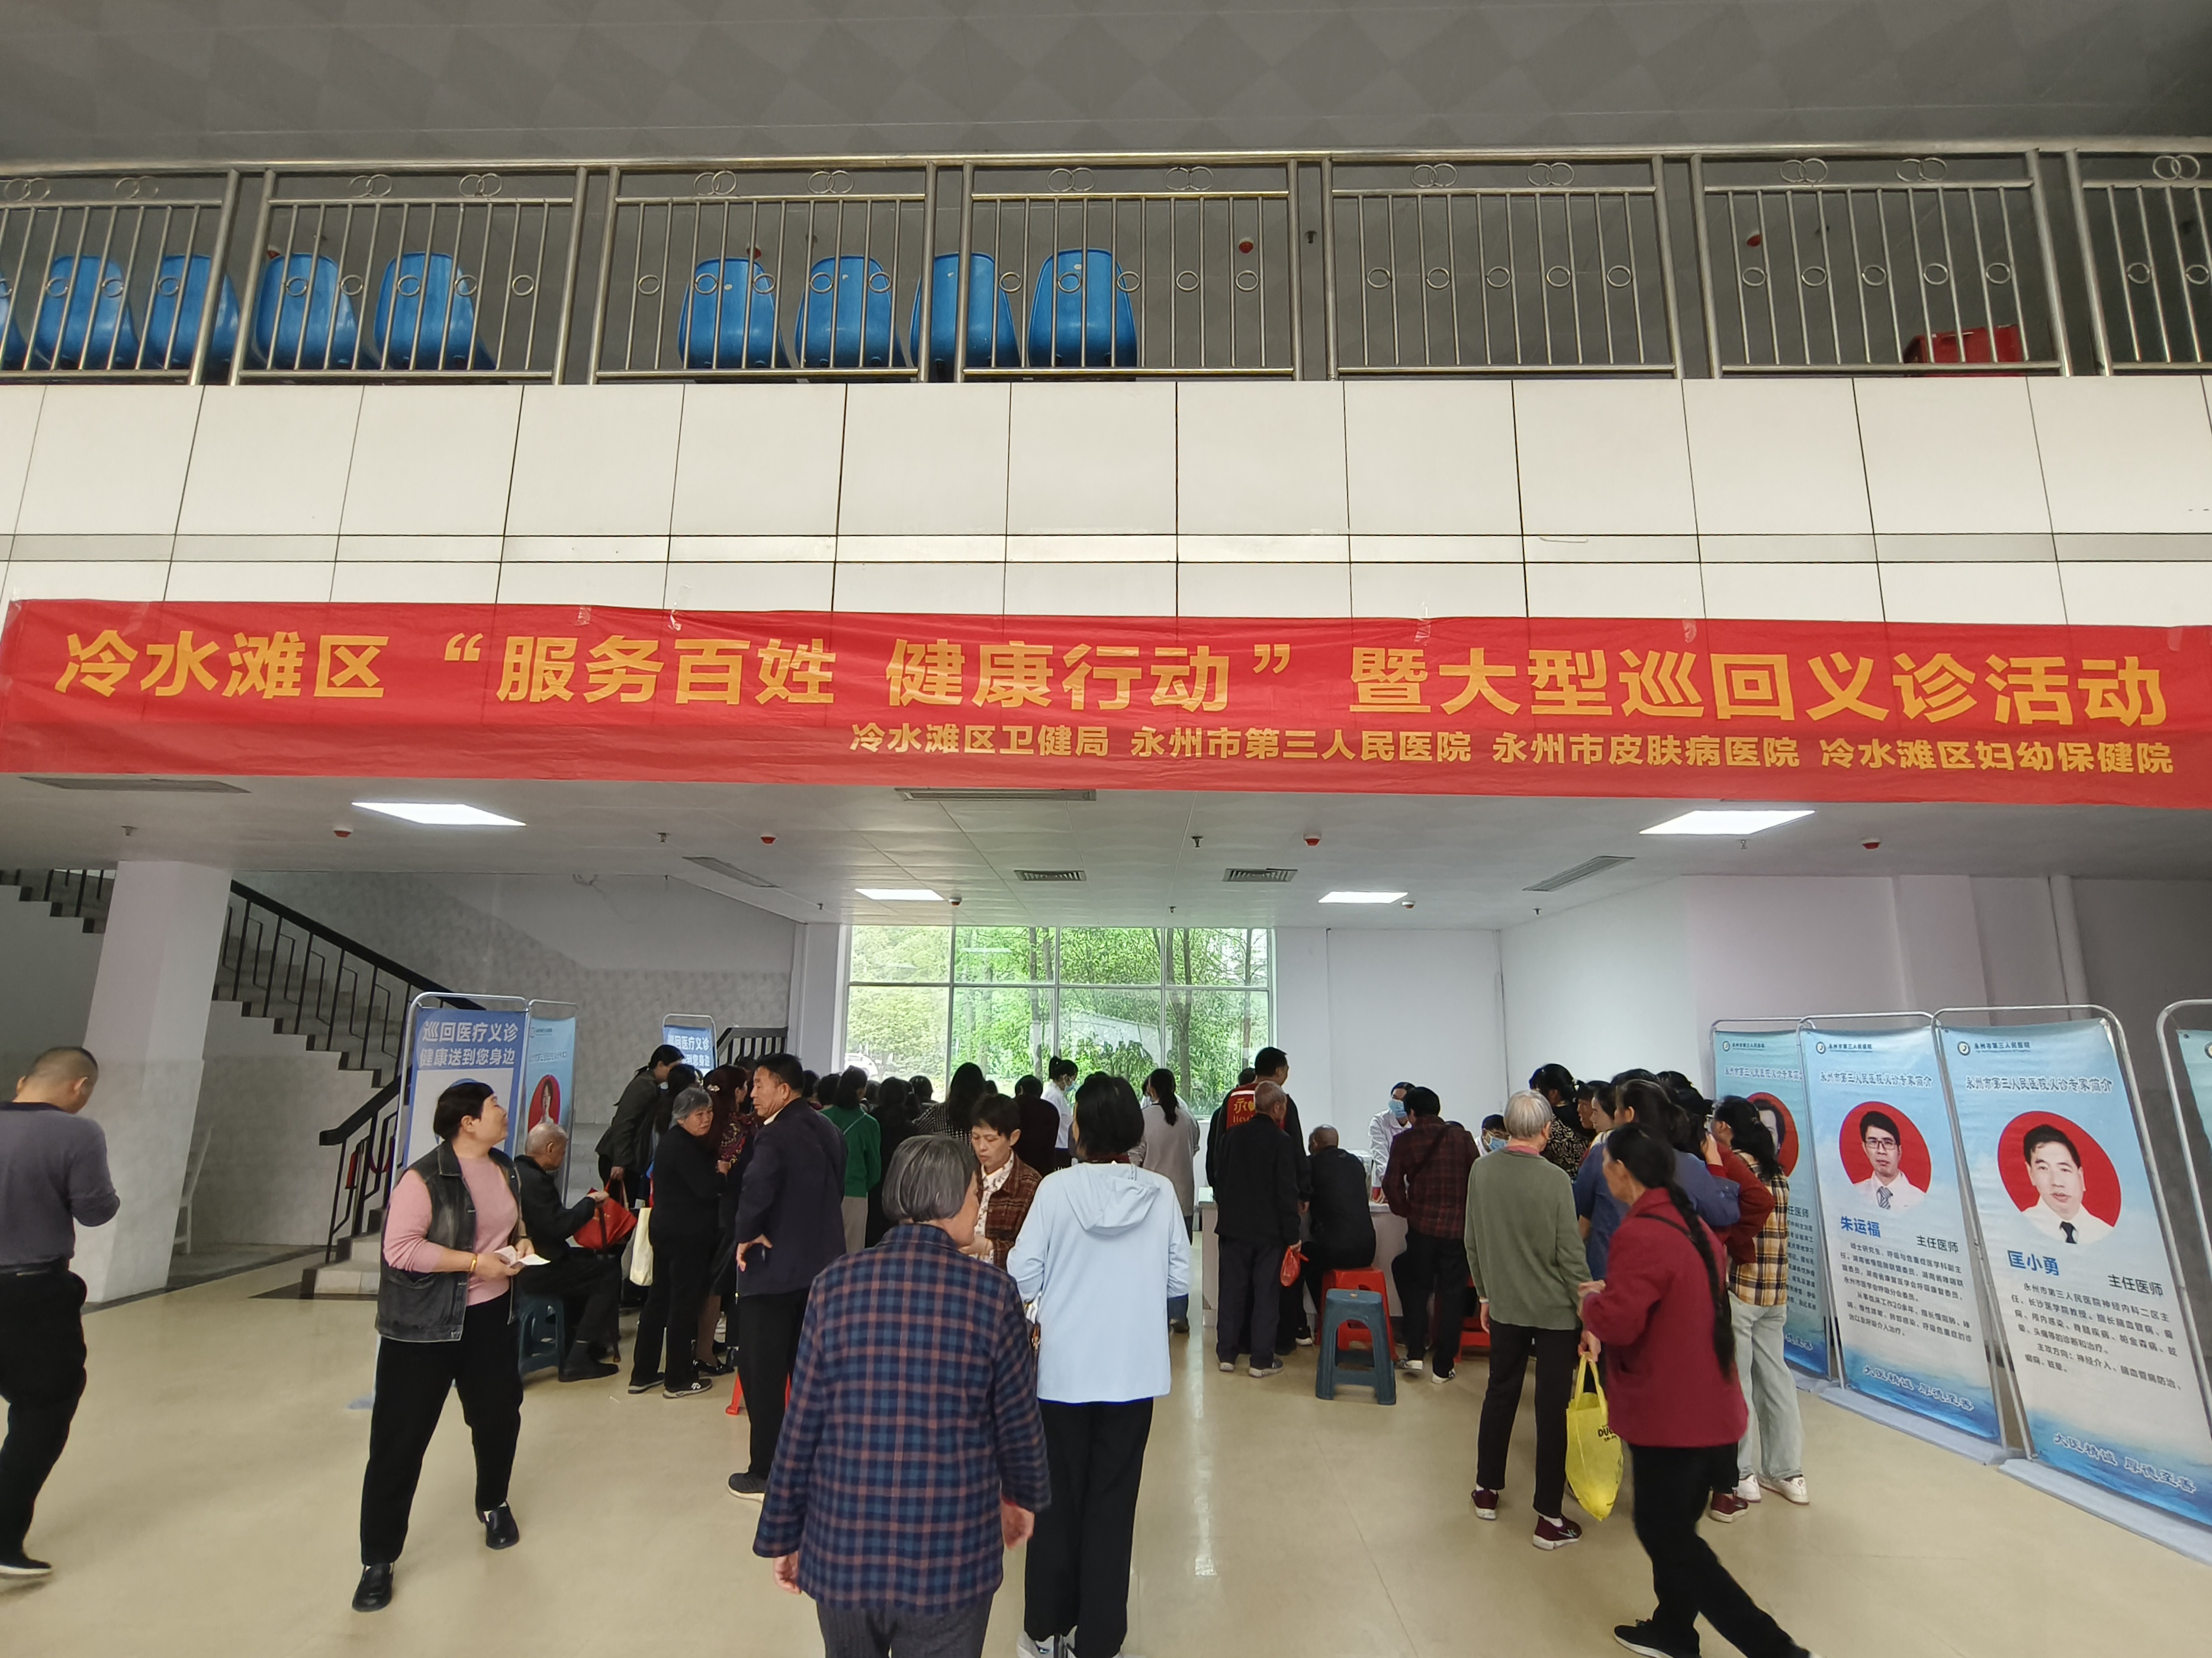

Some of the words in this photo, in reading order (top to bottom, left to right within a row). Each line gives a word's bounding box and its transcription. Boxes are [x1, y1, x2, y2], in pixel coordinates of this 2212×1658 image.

[54, 629, 389, 700] 冷水滩区
[1349, 647, 2167, 727] 暨大型巡回义诊活动
[850, 723, 1109, 757] 冷水滩区卫健局
[1131, 726, 1472, 763] 永州市第三人民医院
[1493, 732, 1801, 768] 永州市皮肤病医院
[1819, 738, 2174, 775] 冷水滩区妇幼保健院
[422, 1021, 518, 1043] 巡回医疗义诊
[420, 1048, 515, 1066] 健康送到您身边
[1965, 1076, 2113, 1093] 永州市第三人民医院义诊专家简介
[1840, 1216, 1881, 1238] 朱运福
[1916, 1235, 1959, 1254] 主任医师
[2007, 1249, 2059, 1276] 匡小勇
[2108, 1274, 2164, 1297] 主任医师
